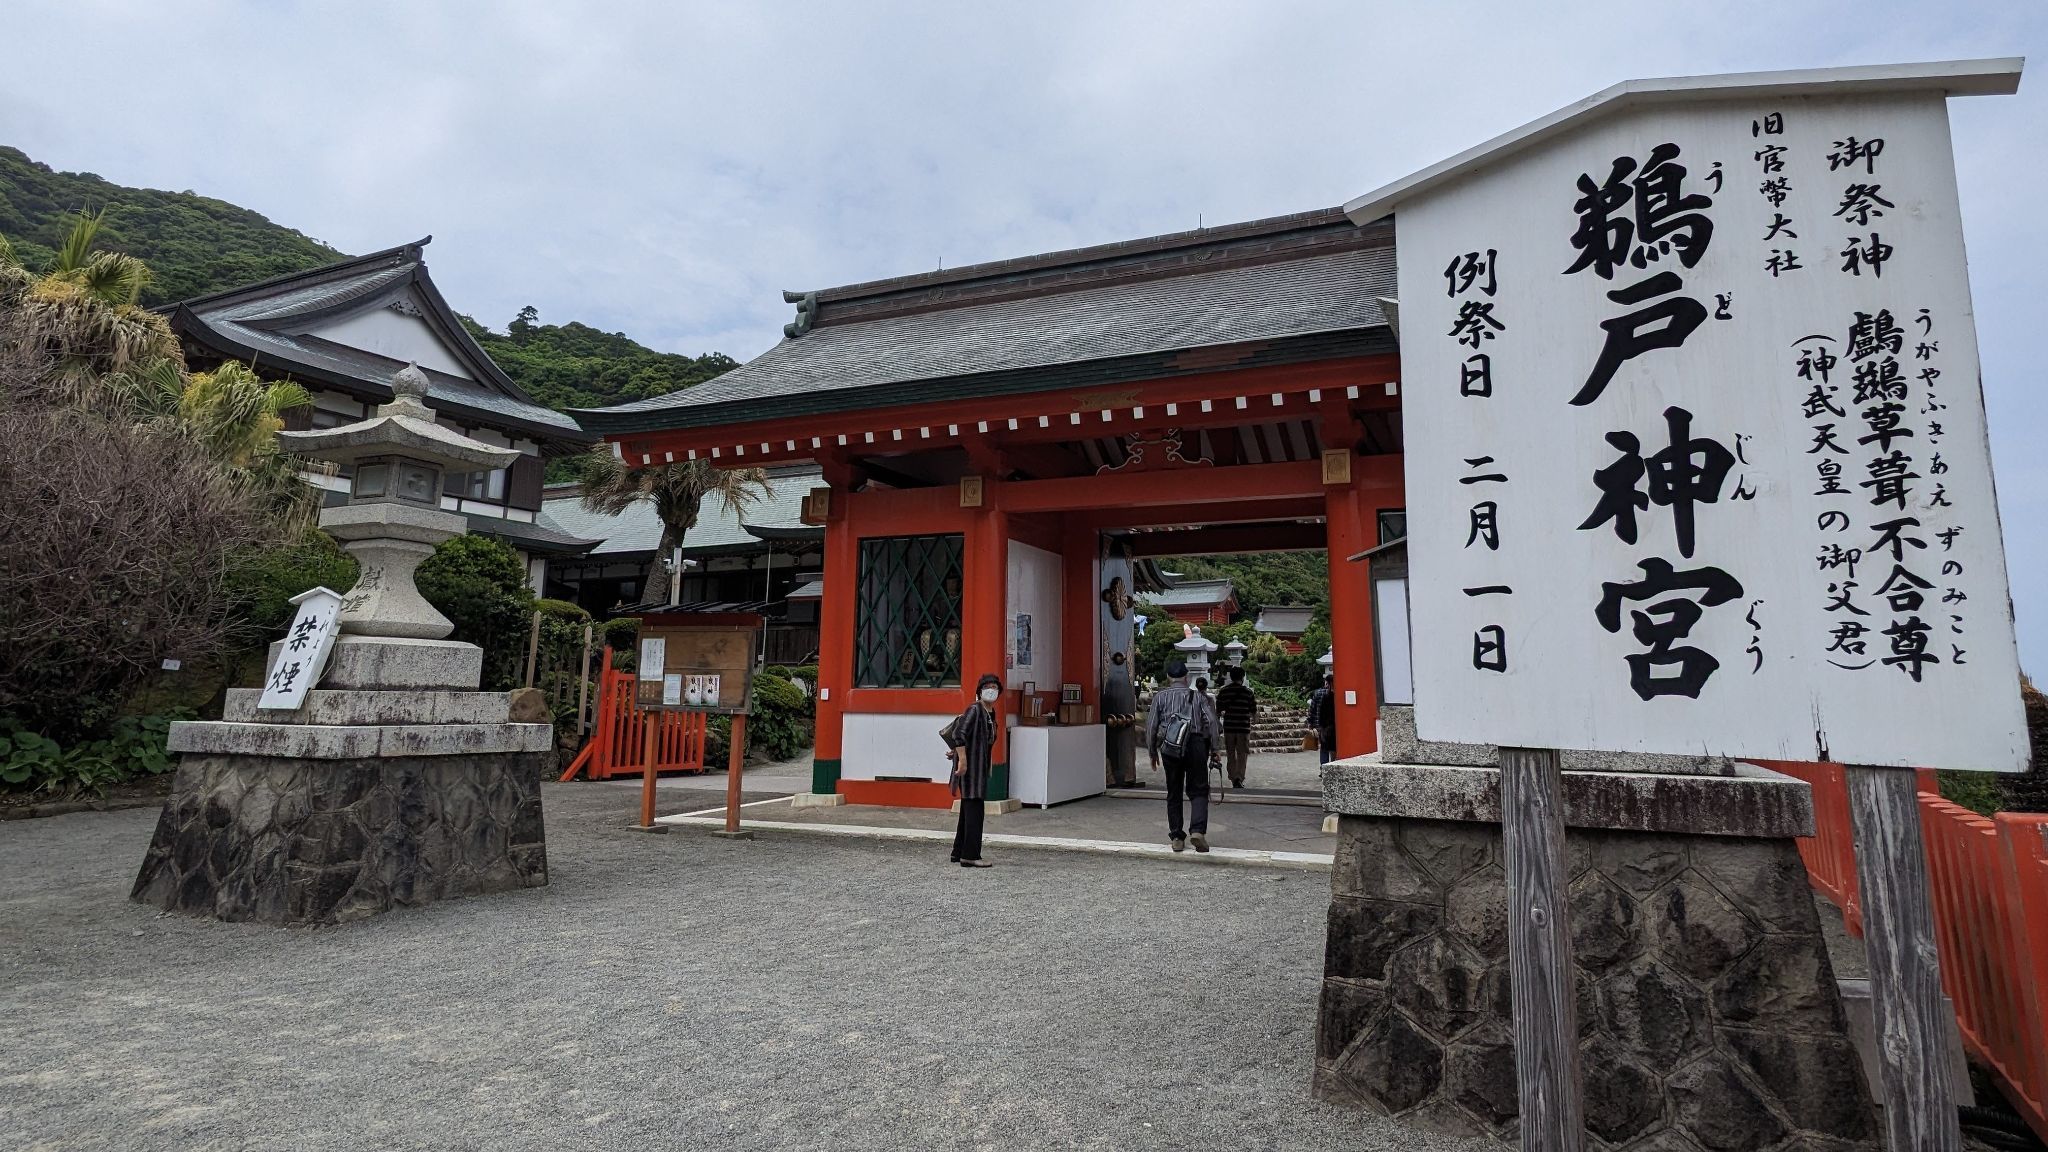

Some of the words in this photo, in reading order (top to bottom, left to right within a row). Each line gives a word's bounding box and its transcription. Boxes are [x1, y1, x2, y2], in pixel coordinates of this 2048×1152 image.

[1752, 112, 1803, 278] 旧官幣大社
[1826, 136, 1895, 279] 御祭神
[1444, 248, 1506, 398] 例祭日
[1563, 142, 1744, 700] 鵜戸神宮
[1704, 161, 1723, 194] う
[1714, 291, 1733, 321] ど
[1730, 433, 1757, 501] じん
[1746, 599, 1765, 675] ぐう
[1459, 456, 1513, 673] 二月一日
[266, 615, 318, 694] 禁煙
